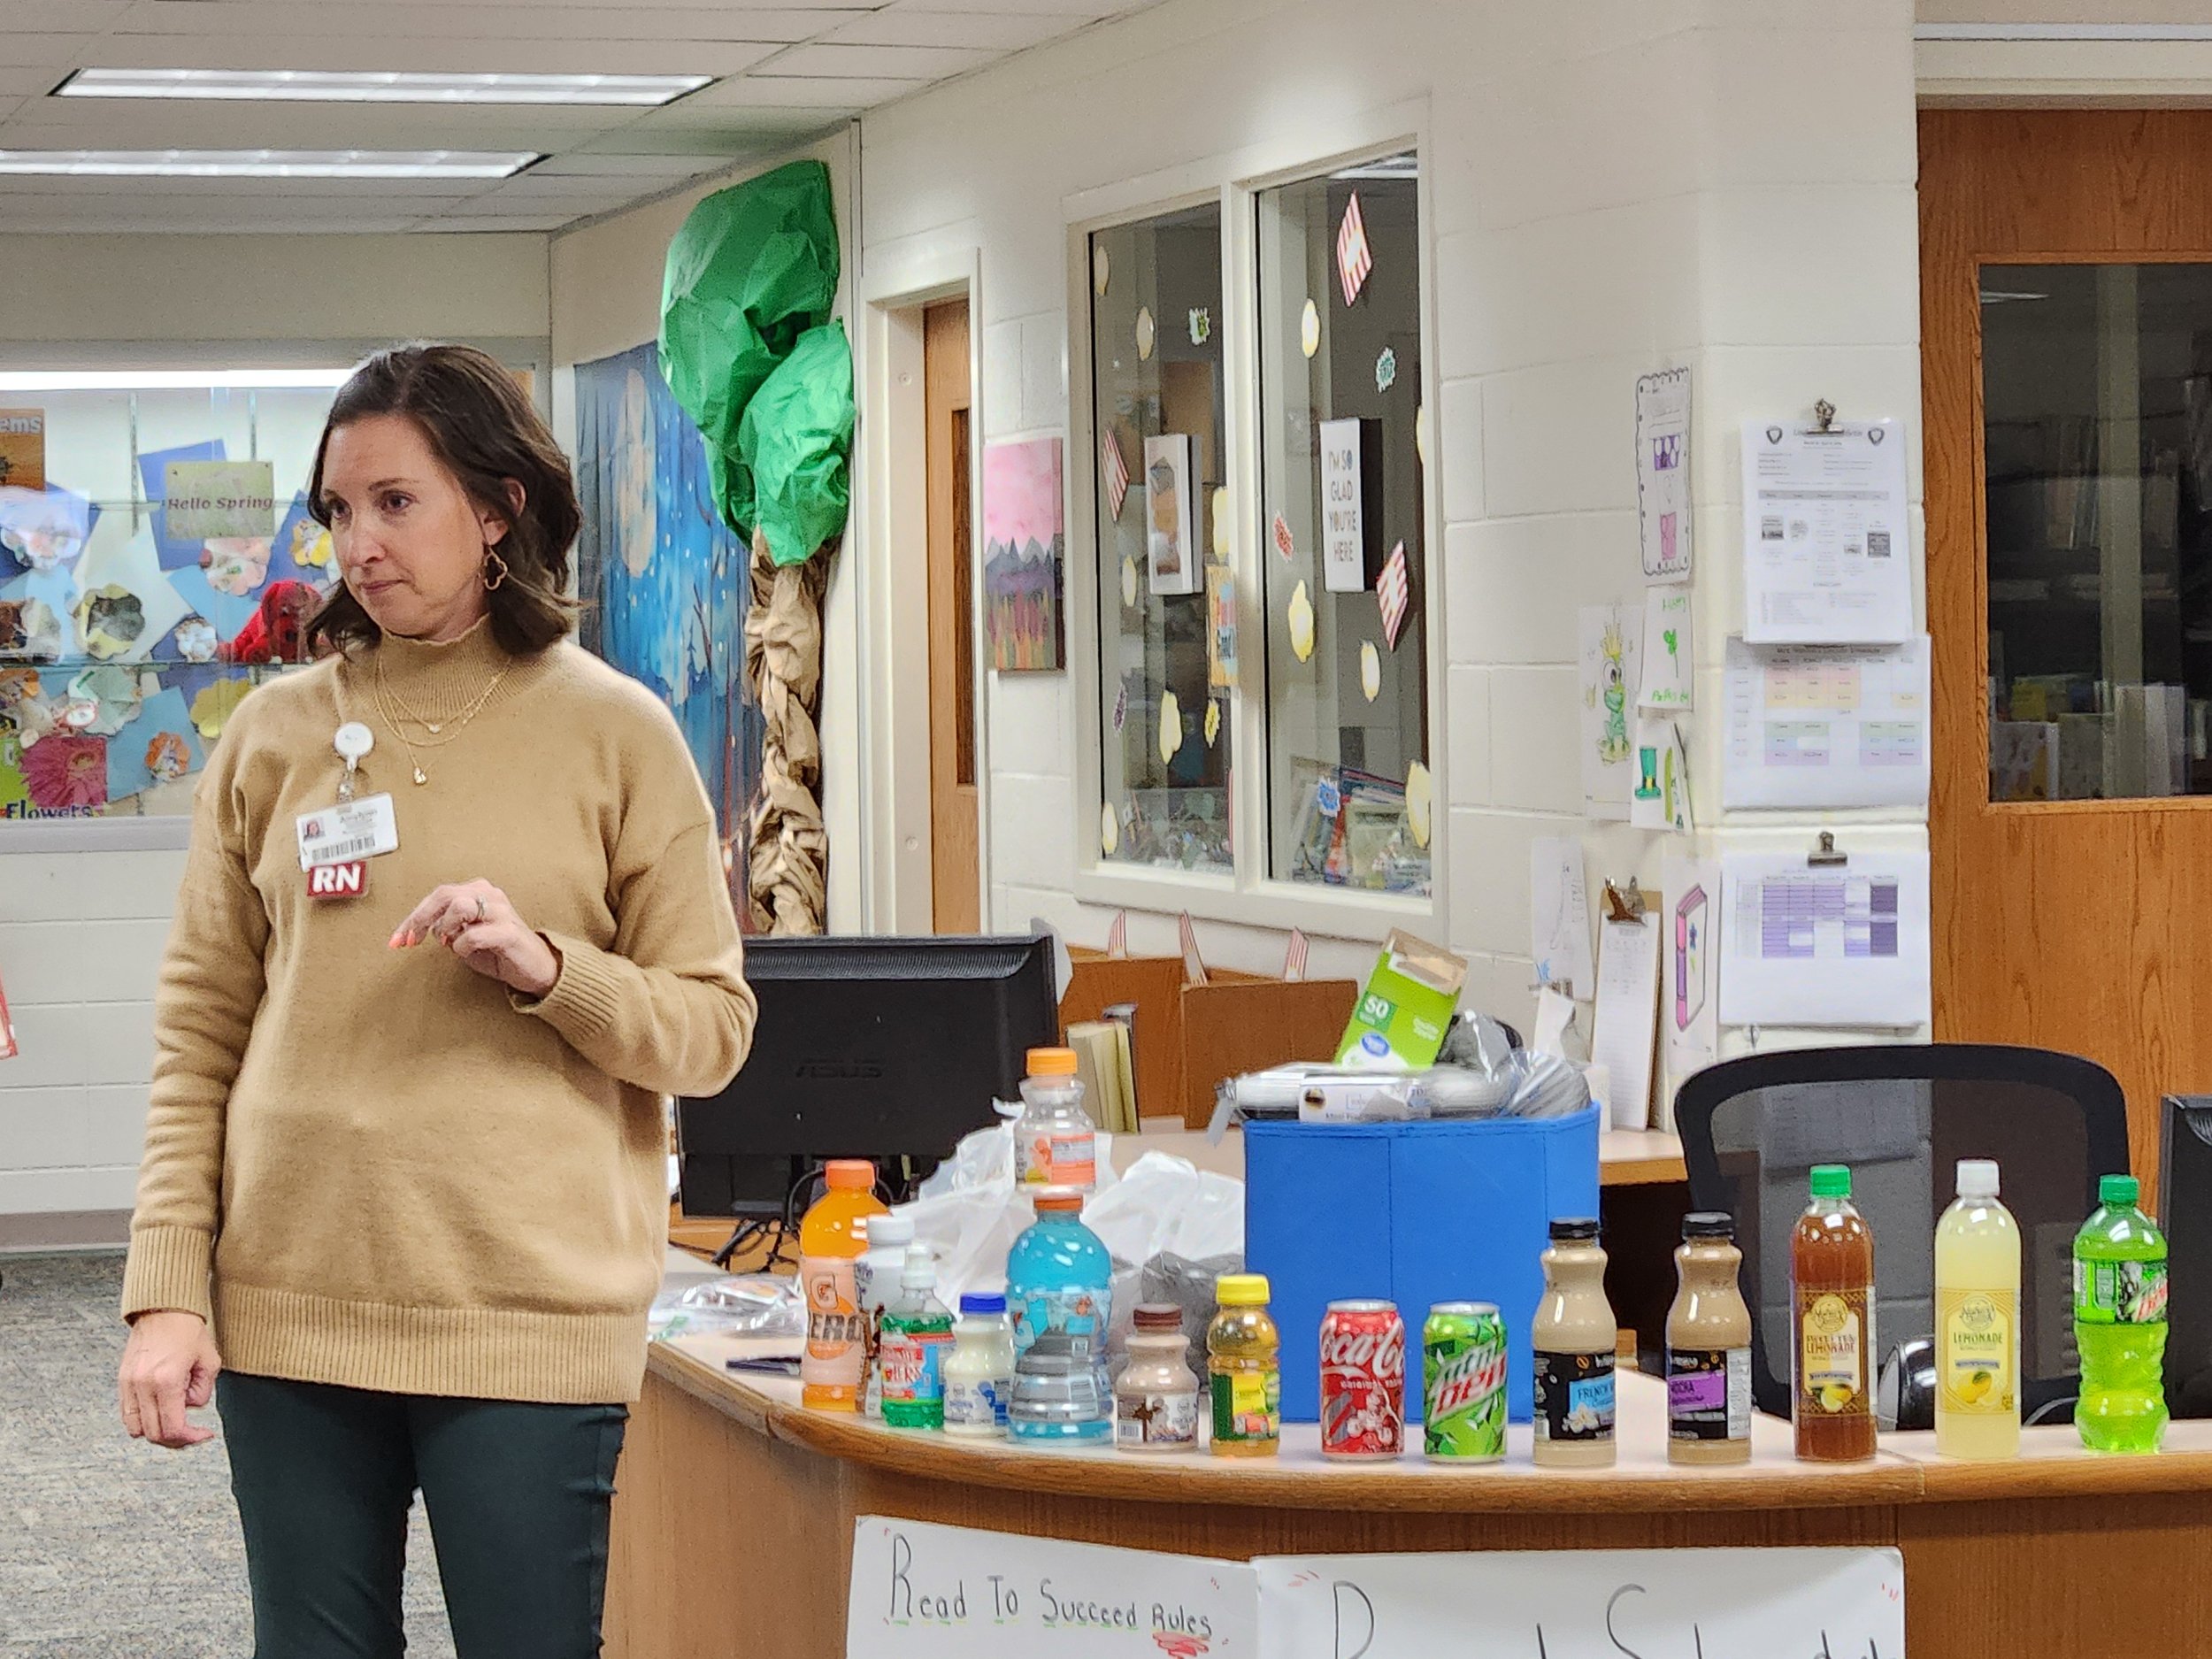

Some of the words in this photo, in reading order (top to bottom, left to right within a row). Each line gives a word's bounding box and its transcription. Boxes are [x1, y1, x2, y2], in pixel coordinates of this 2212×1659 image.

[1341, 448, 1353, 471] SO
[1331, 480, 1354, 502] GLAD
[168, 497, 211, 511] Hello
[216, 495, 274, 512] Spring
[1329, 510, 1357, 532] YOU'RE
[1333, 540, 1355, 562] HERE
[312, 864, 361, 893] RN
[1363, 994, 1389, 1019] 50
[795, 1060, 883, 1079] ASUS
[1806, 1342, 1855, 1355] LEMONADE
[1953, 1331, 2003, 1344] LEMONADE
[890, 1532, 967, 1618] Read
[987, 1575, 1018, 1617] To
[1039, 1578, 1137, 1629] Succeed
[1151, 1602, 1213, 1640] Rules
